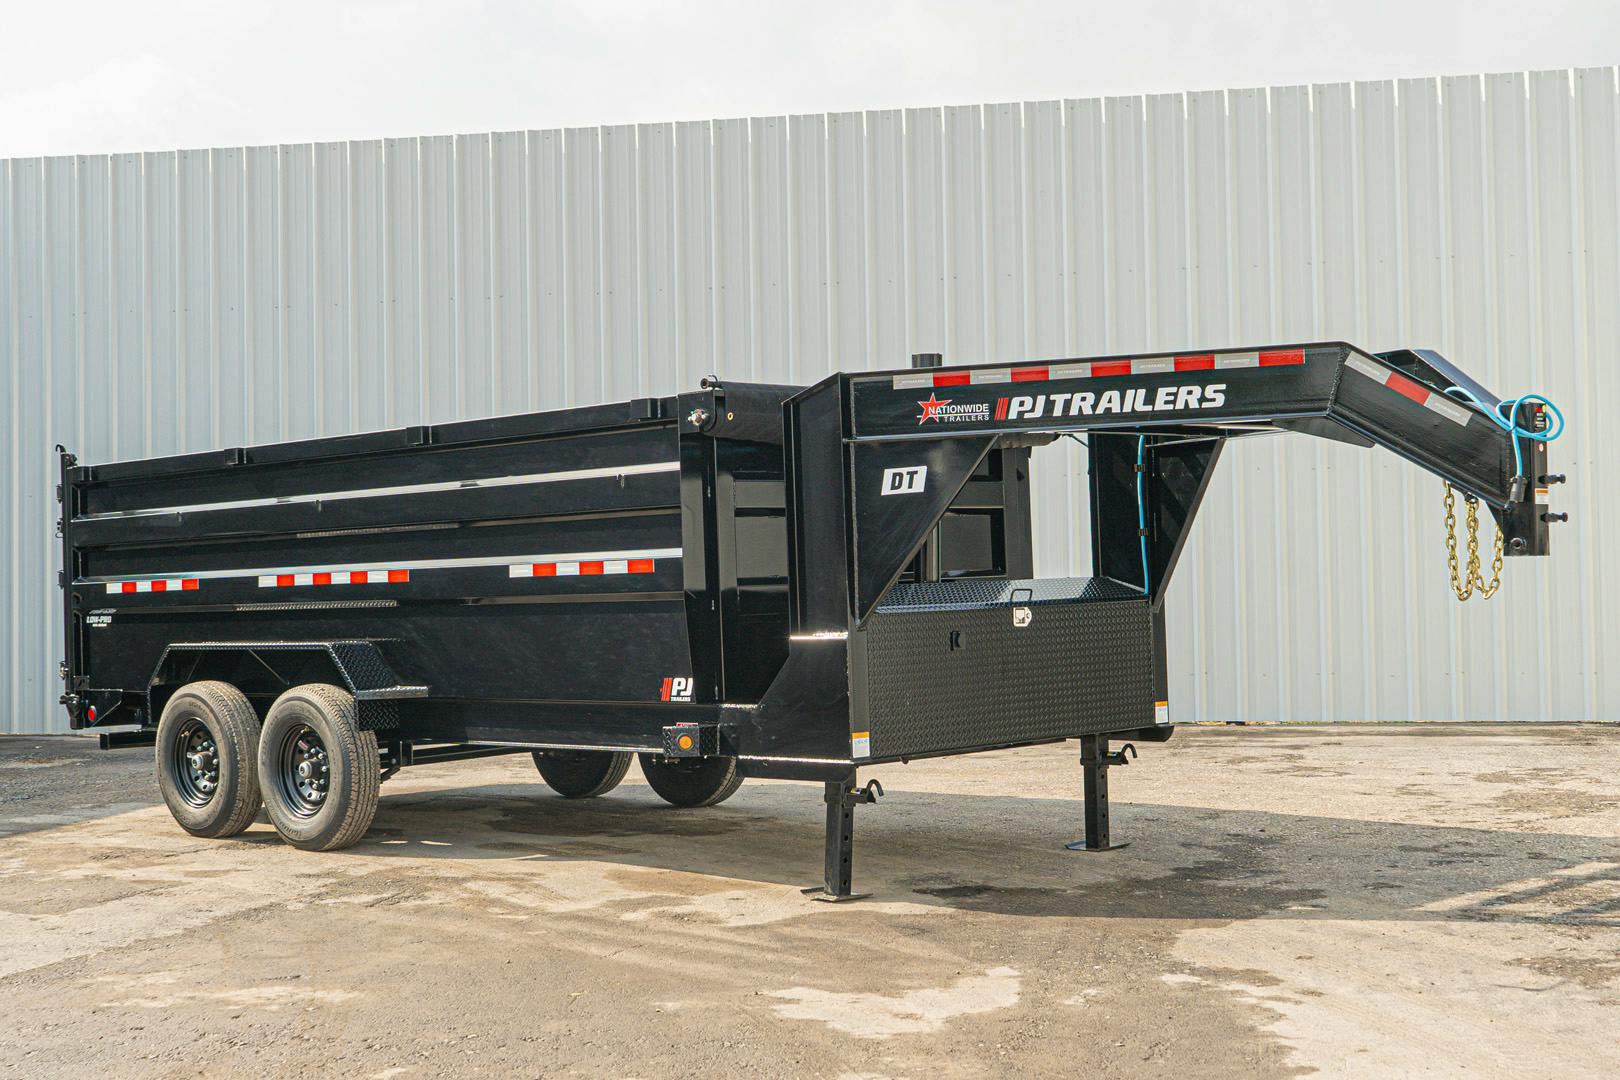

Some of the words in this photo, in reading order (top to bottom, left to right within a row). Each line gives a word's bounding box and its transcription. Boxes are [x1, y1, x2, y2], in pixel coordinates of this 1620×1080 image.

[928, 403, 989, 415] NATIONWIDE
[1007, 395, 1046, 420] PJ
[1049, 384, 1227, 417] TRAILERS
[943, 414, 990, 423] TRAILERS
[890, 470, 919, 491] DT
[671, 677, 693, 696] PJ
